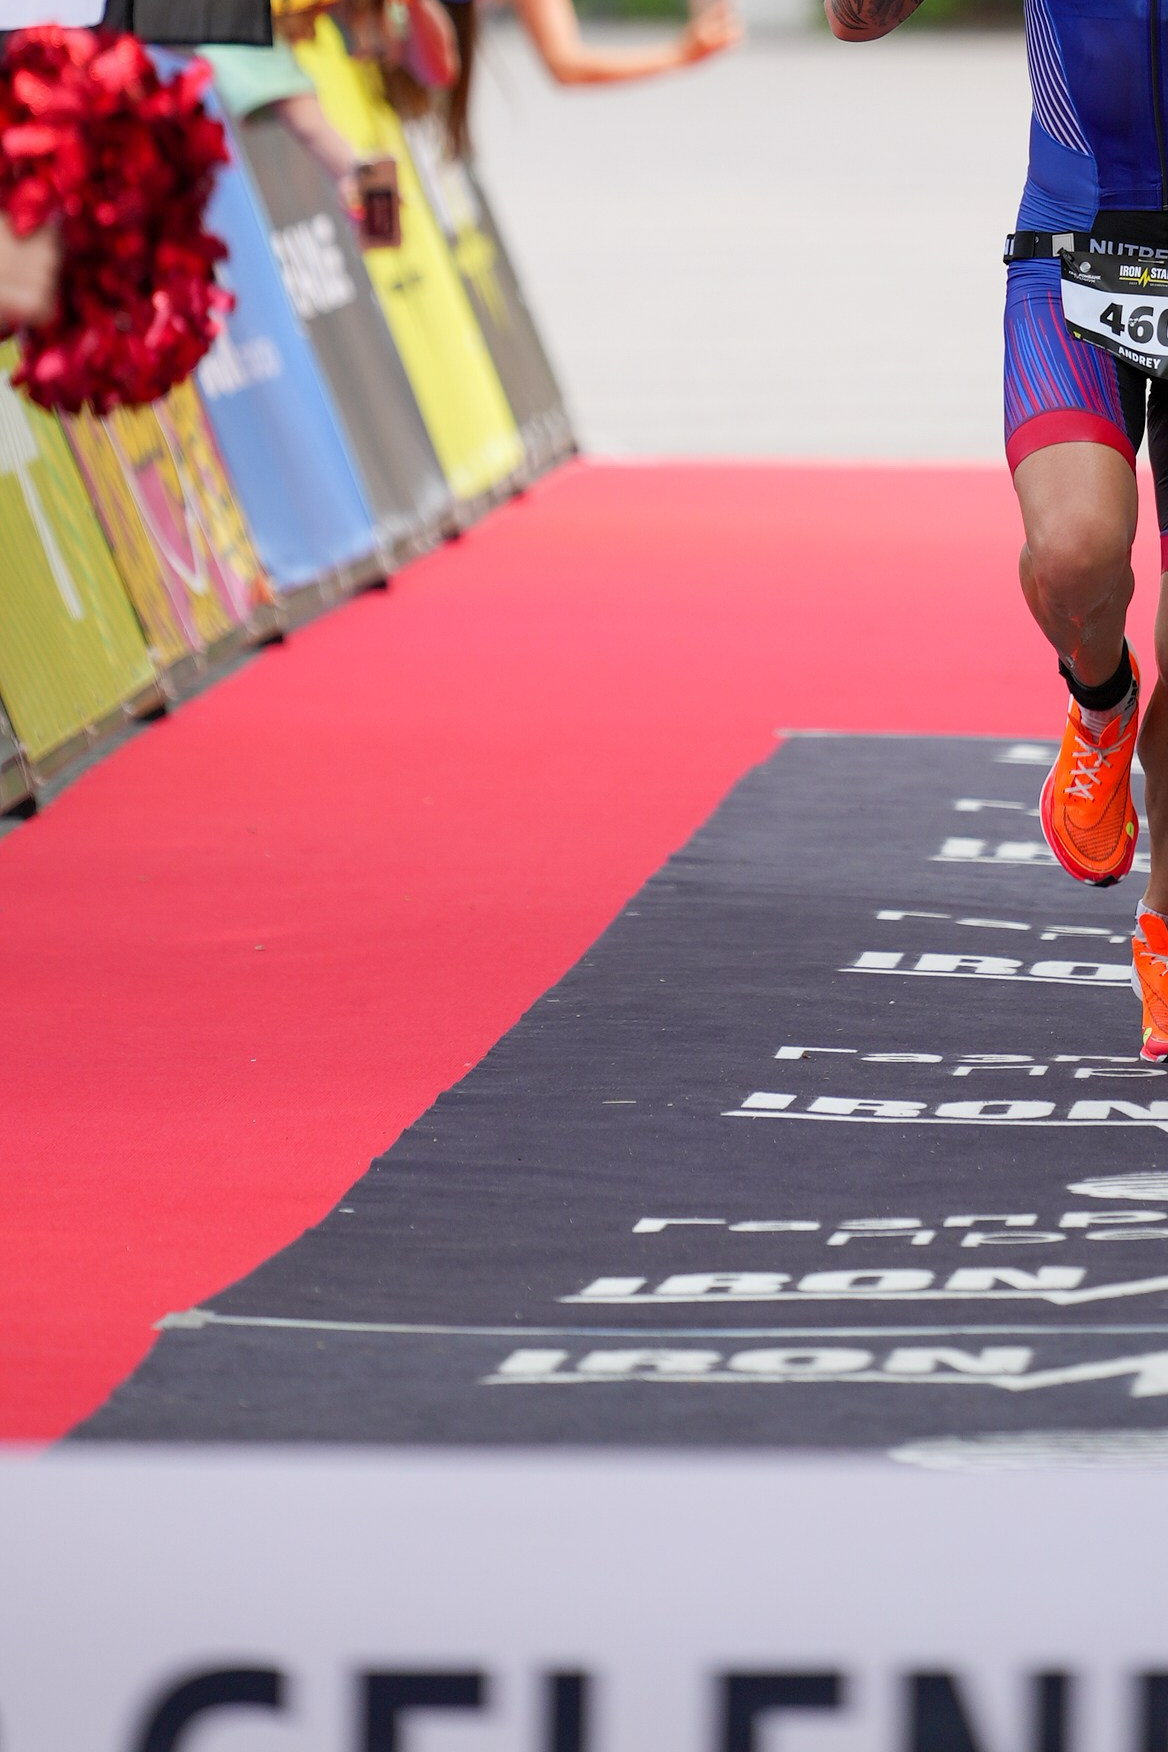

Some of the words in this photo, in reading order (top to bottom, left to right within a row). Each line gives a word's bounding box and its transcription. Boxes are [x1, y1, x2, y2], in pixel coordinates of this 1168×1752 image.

[1120, 265, 1141, 278] IRON
[1118, 346, 1161, 369] ANDREY
[580, 1264, 1088, 1295] IRON
[500, 1345, 1034, 1375] IRON
